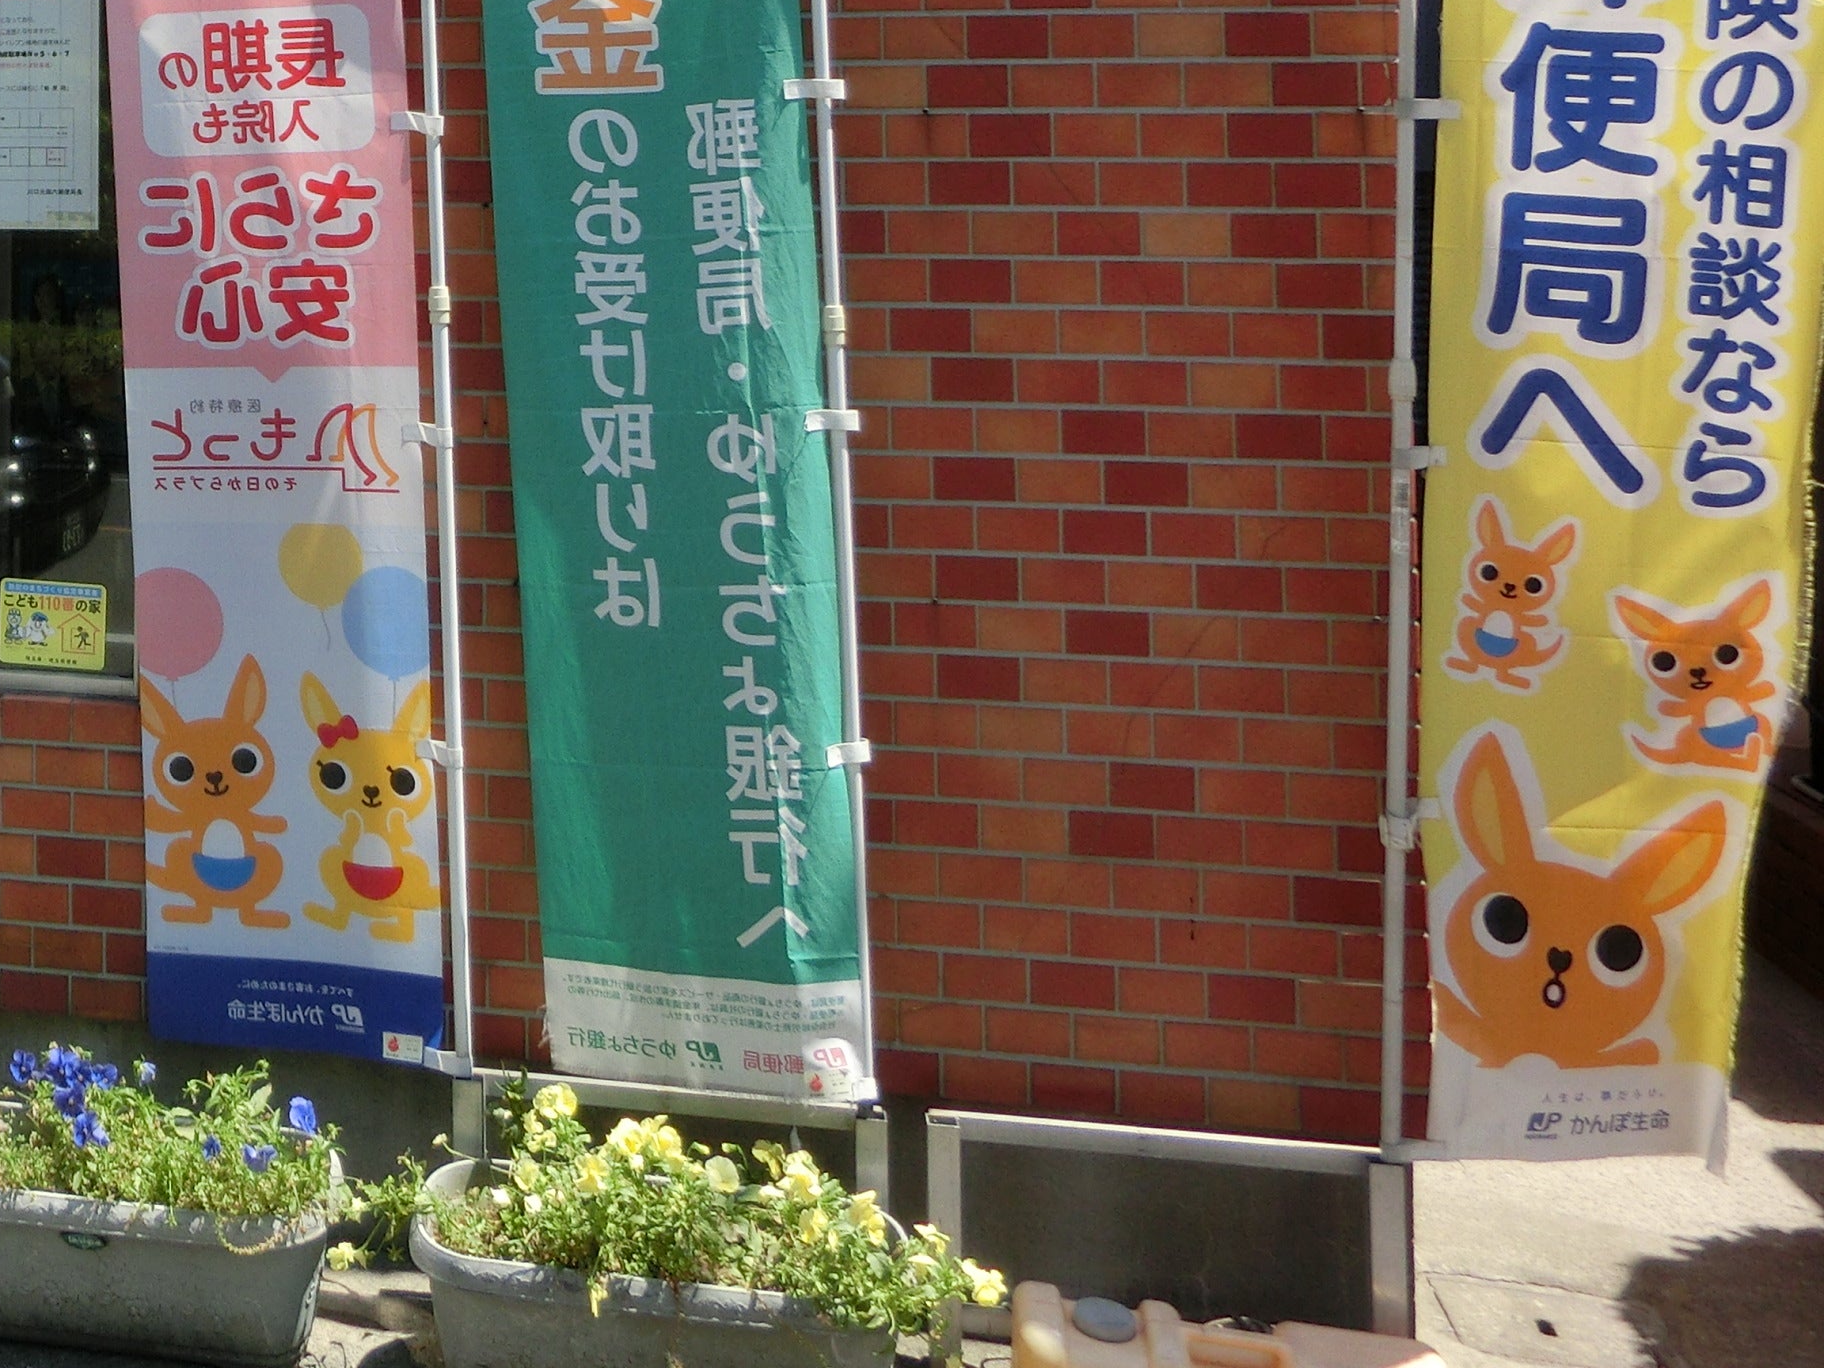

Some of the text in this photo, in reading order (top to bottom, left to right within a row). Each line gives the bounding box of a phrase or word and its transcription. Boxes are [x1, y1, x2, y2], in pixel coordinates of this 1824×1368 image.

[3, 593, 102, 614] こども110番の家
[1526, 1108, 1671, 1135] JP かんぽ生命
